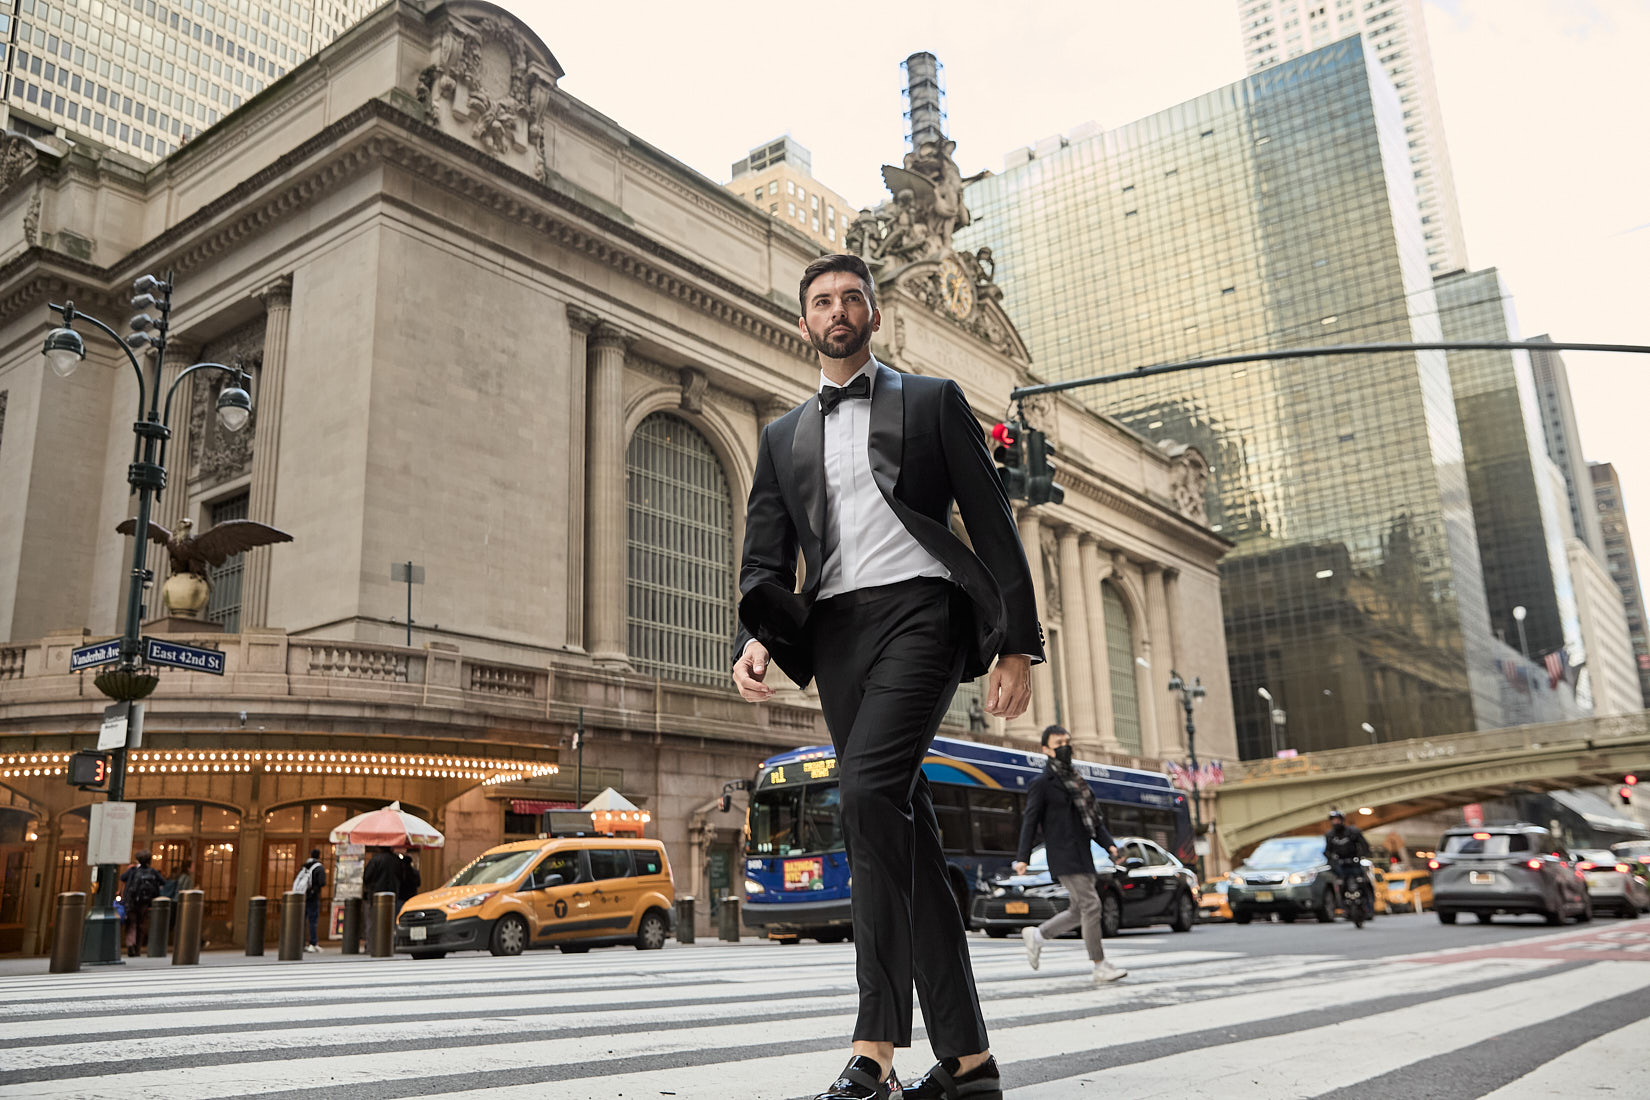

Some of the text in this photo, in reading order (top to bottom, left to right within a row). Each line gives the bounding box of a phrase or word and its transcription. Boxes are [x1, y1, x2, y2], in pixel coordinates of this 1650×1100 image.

[73, 646, 120, 666] Vanderbilt Ave
[151, 645, 220, 669] East 42nd St
